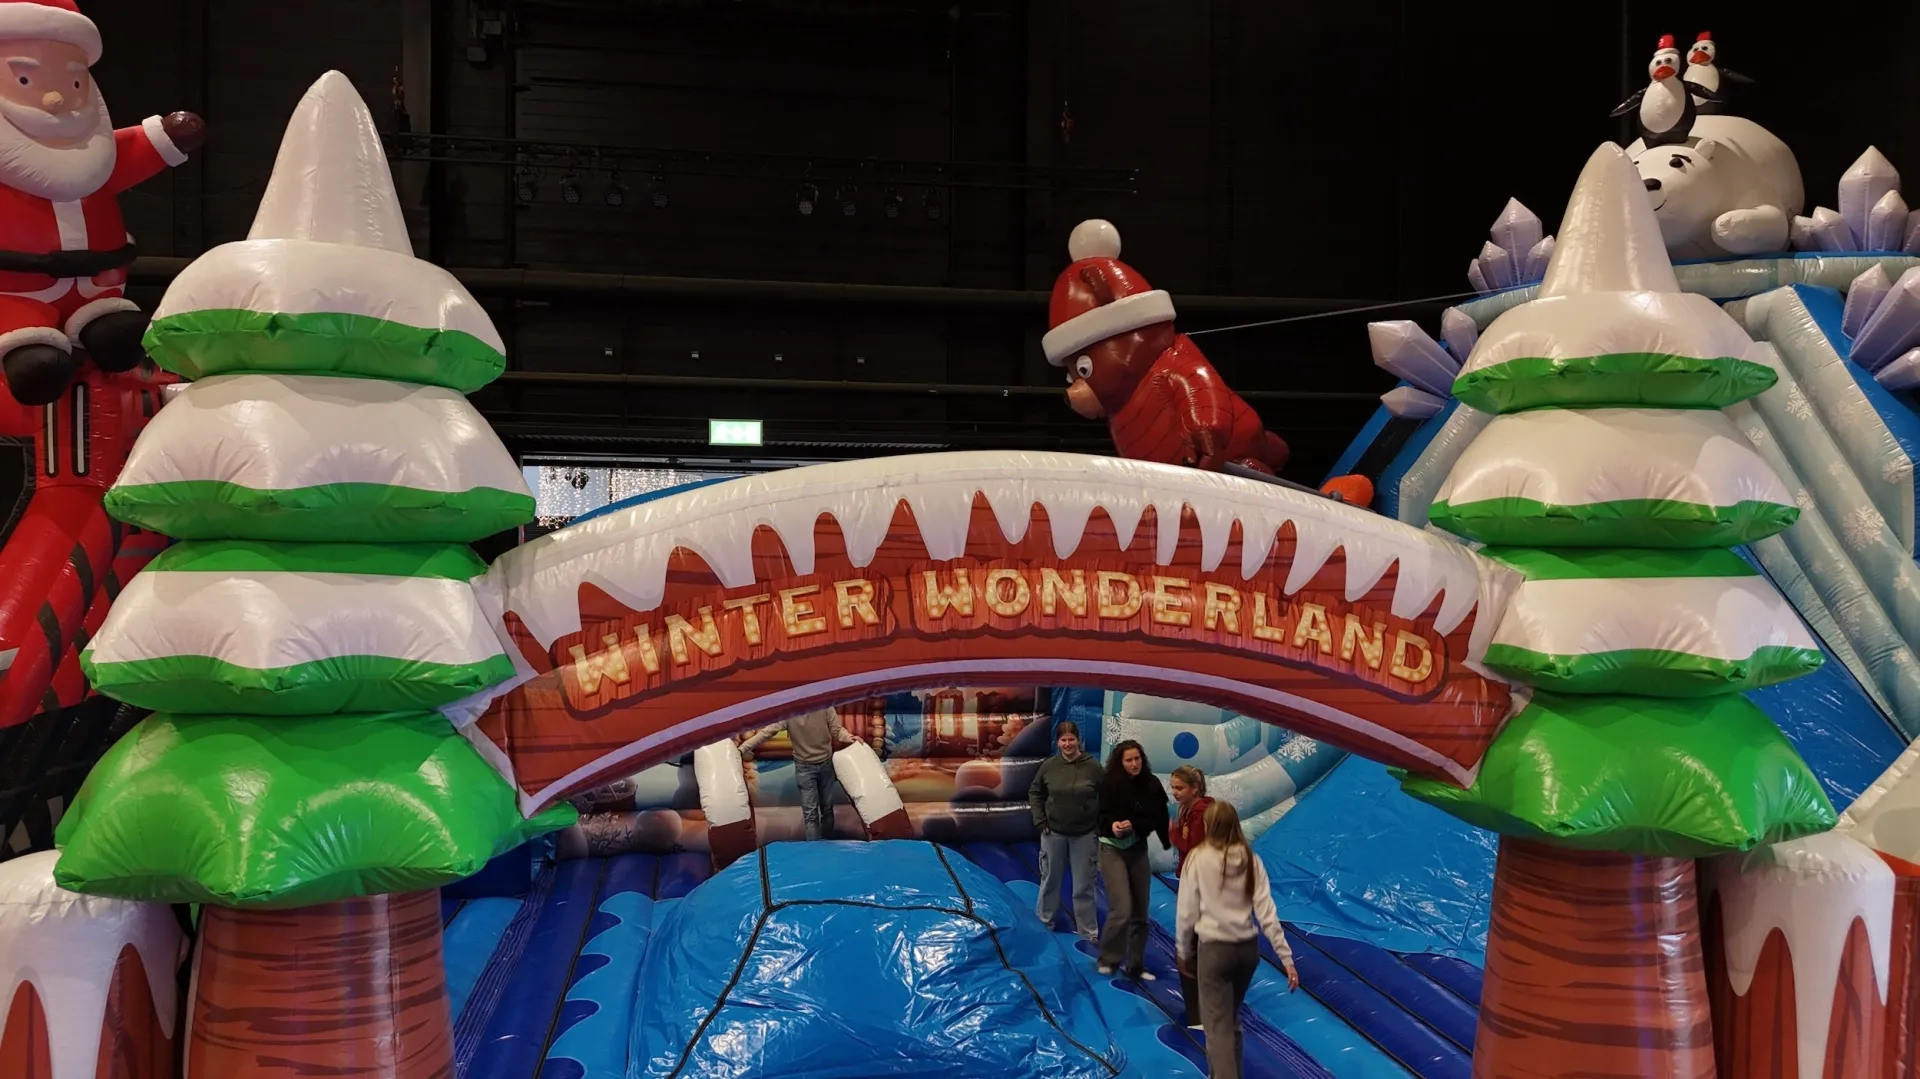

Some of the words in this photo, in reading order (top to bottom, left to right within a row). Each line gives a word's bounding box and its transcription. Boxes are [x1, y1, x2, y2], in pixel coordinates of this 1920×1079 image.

[1003, 389, 1009, 397] 2
[568, 578, 880, 697] WINTER
[922, 568, 1434, 684] WONDERLAND
